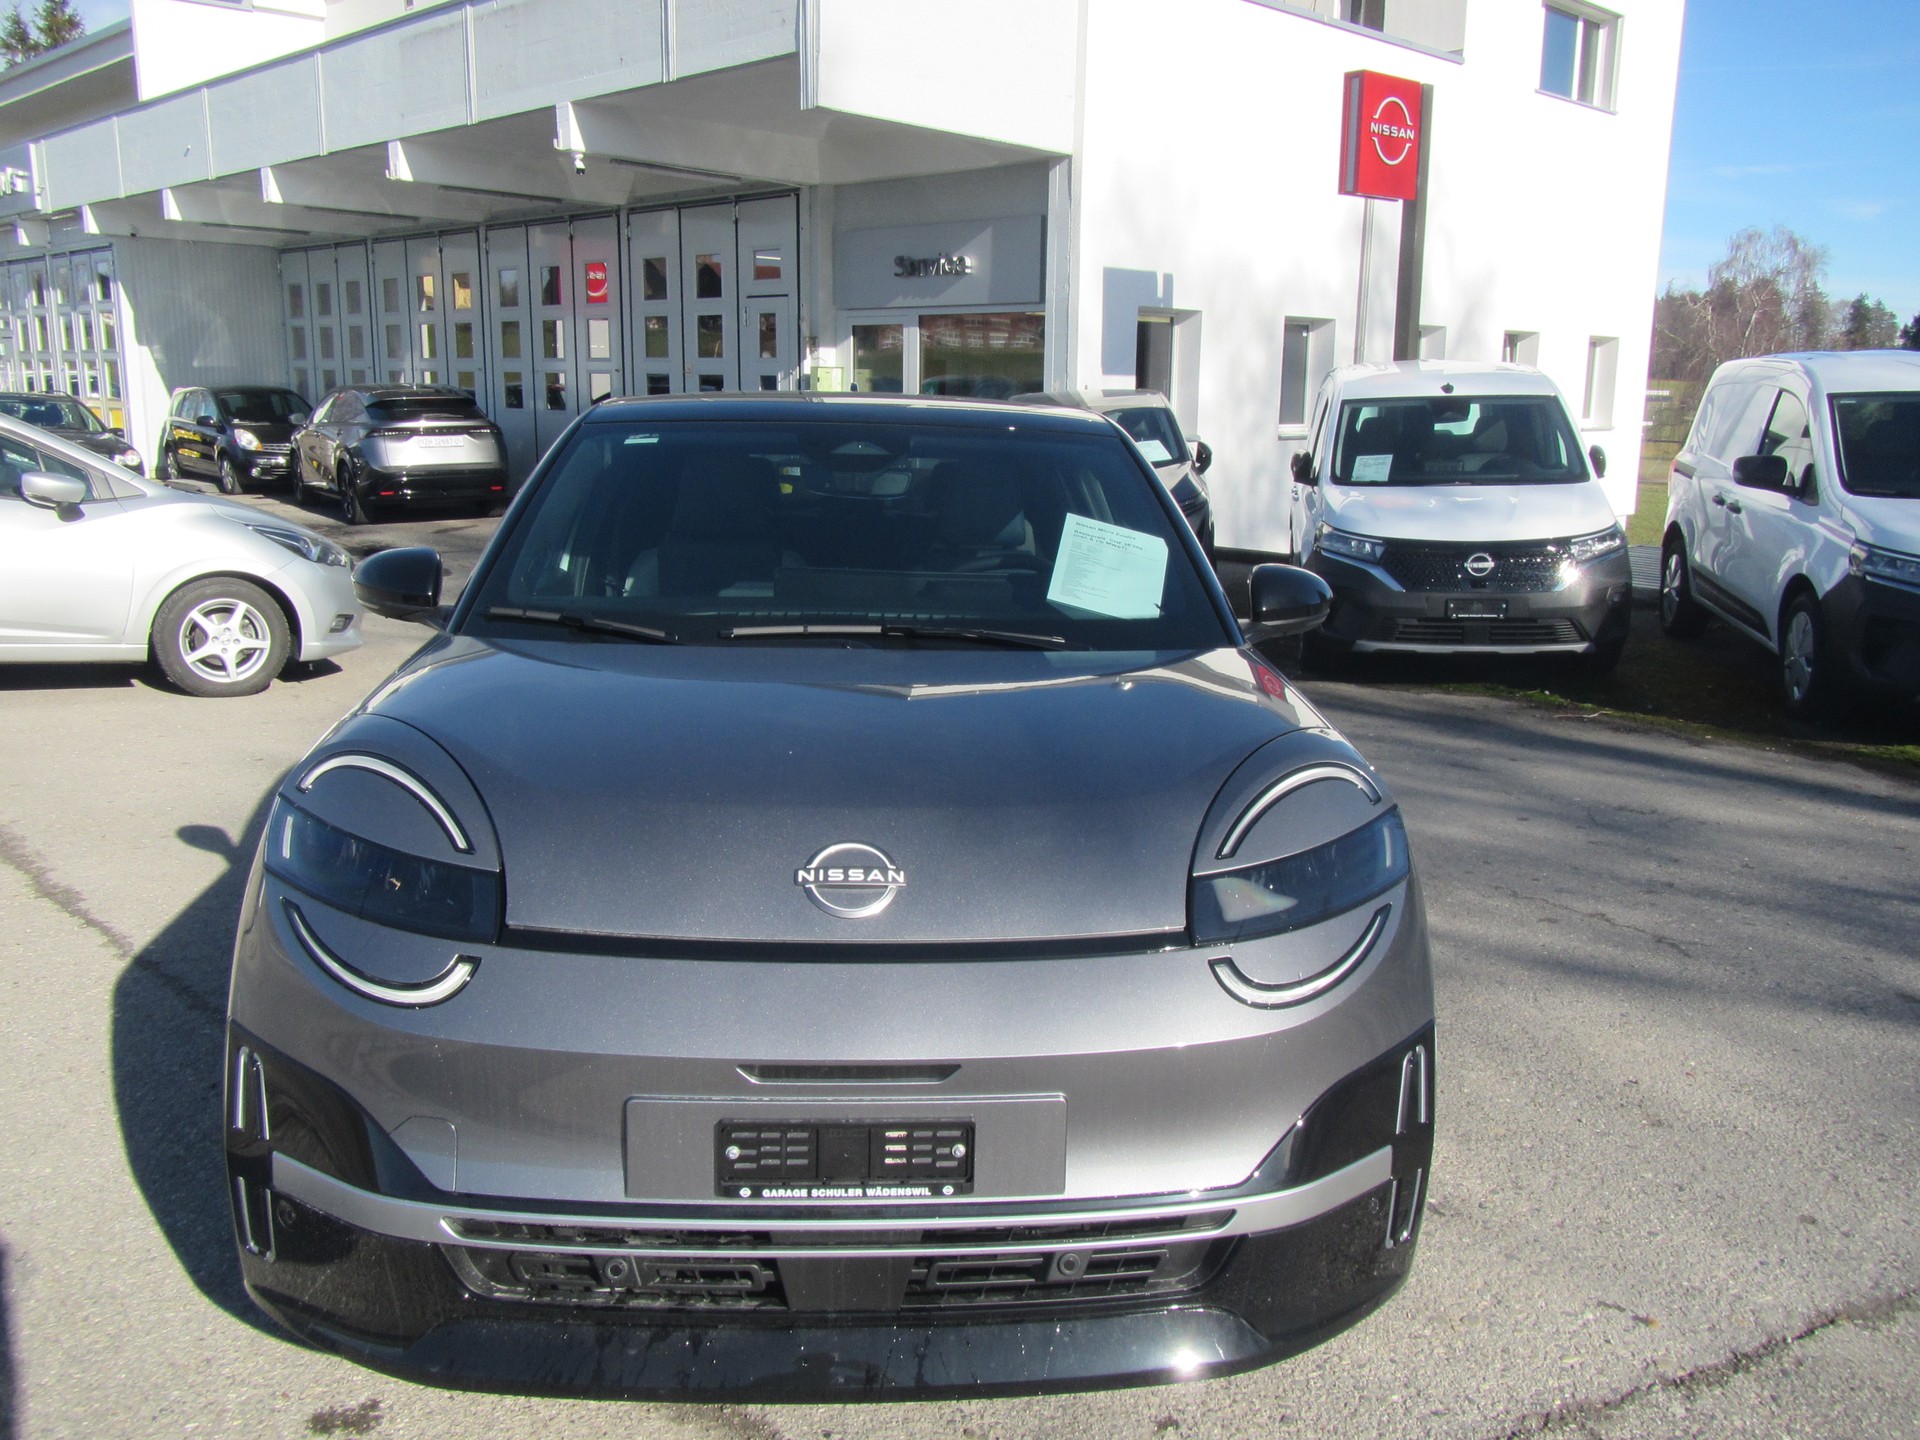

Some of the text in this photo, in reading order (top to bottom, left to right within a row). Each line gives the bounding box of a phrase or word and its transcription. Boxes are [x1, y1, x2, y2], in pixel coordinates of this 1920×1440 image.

[1370, 121, 1415, 140] NISSAN
[797, 868, 905, 883] NISSAN
[762, 1186, 932, 1198] GARAGE SCHULER WÄDENSWIL
